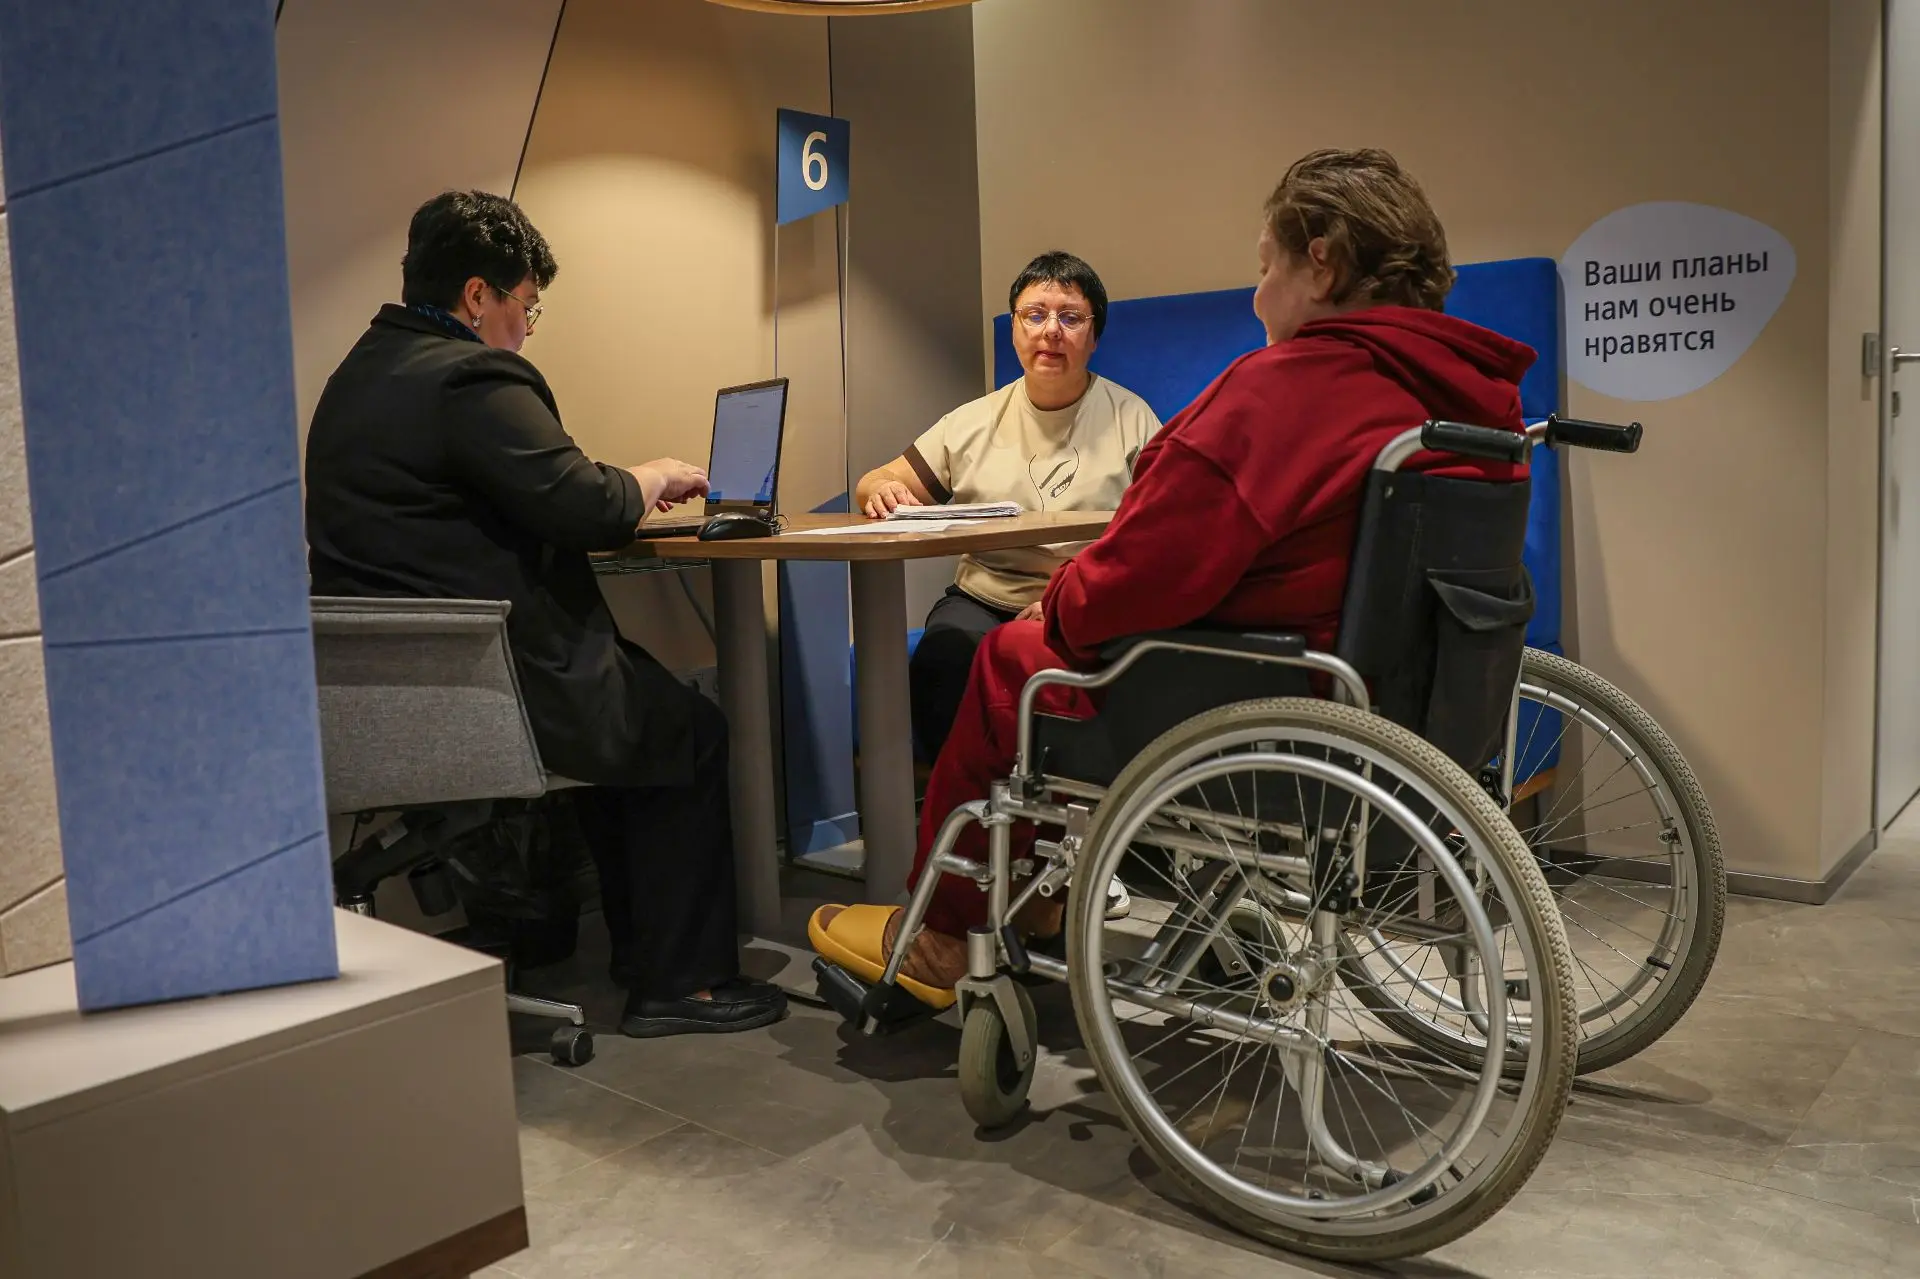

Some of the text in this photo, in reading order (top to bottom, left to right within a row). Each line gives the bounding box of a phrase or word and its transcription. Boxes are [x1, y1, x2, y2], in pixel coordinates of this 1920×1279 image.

[802, 131, 828, 191] 6
[1584, 251, 1769, 287] Ваши планы
[1584, 292, 1735, 322] нам очень
[1584, 330, 1715, 363] нравятся
